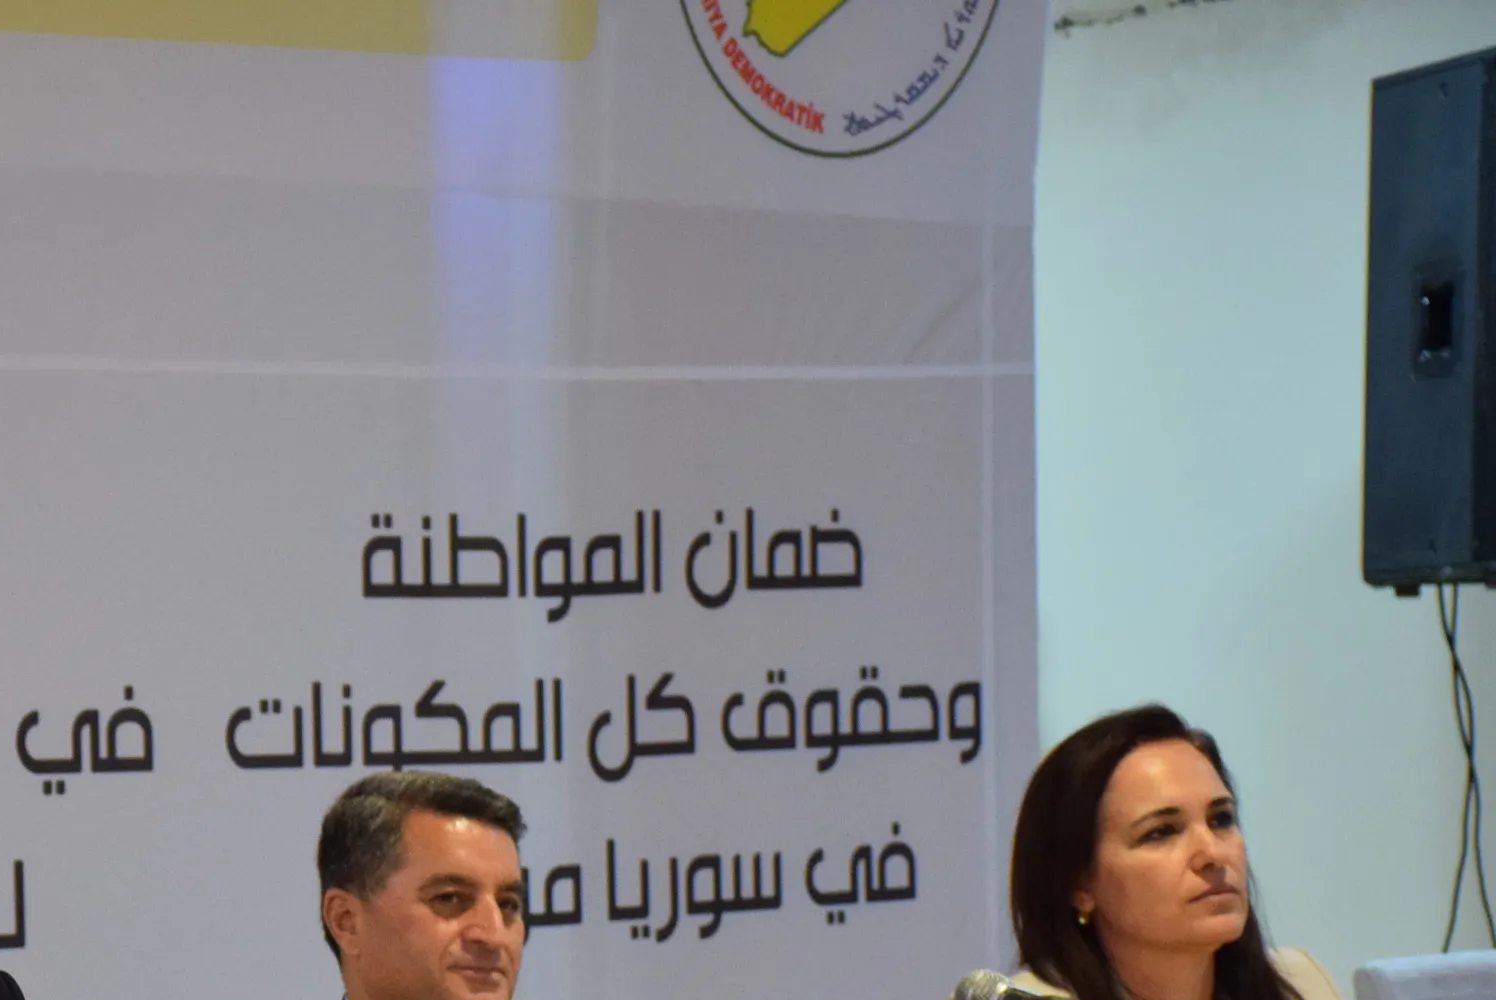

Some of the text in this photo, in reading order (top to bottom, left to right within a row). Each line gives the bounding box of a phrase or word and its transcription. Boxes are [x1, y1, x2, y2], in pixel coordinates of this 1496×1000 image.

[363, 508, 863, 623] ضمان المواطنة
[16, 686, 154, 795] في
[226, 666, 982, 782] وحقوق كل المكونات
[607, 839, 782, 943] سوريا
[805, 822, 916, 925] في
